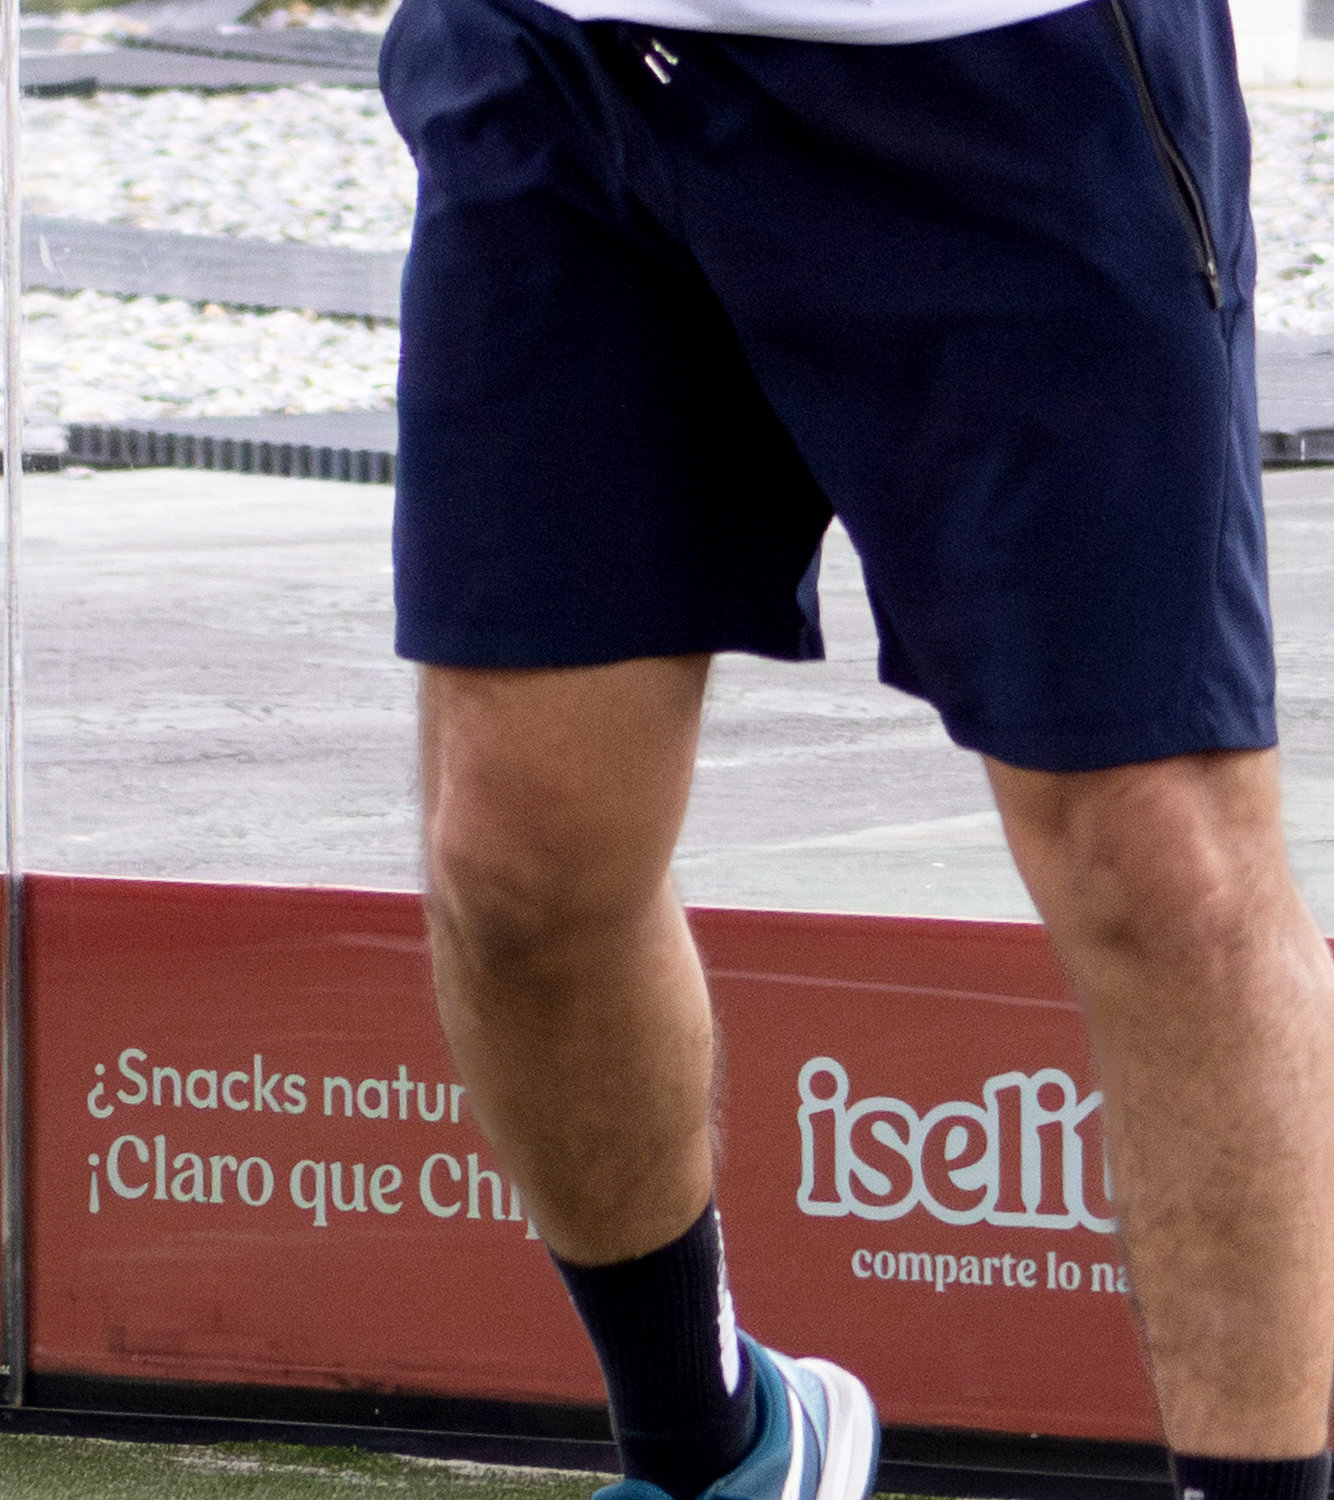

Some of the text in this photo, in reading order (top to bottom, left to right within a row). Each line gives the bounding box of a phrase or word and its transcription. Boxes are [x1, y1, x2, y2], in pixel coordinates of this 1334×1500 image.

[88, 1048, 465, 1123] ¿Snacks natur
[88, 1135, 274, 1213] ¡Claro
[290, 1160, 402, 1226] que
[852, 1249, 1037, 1292] comparte
[1047, 1252, 1081, 1290] lo
